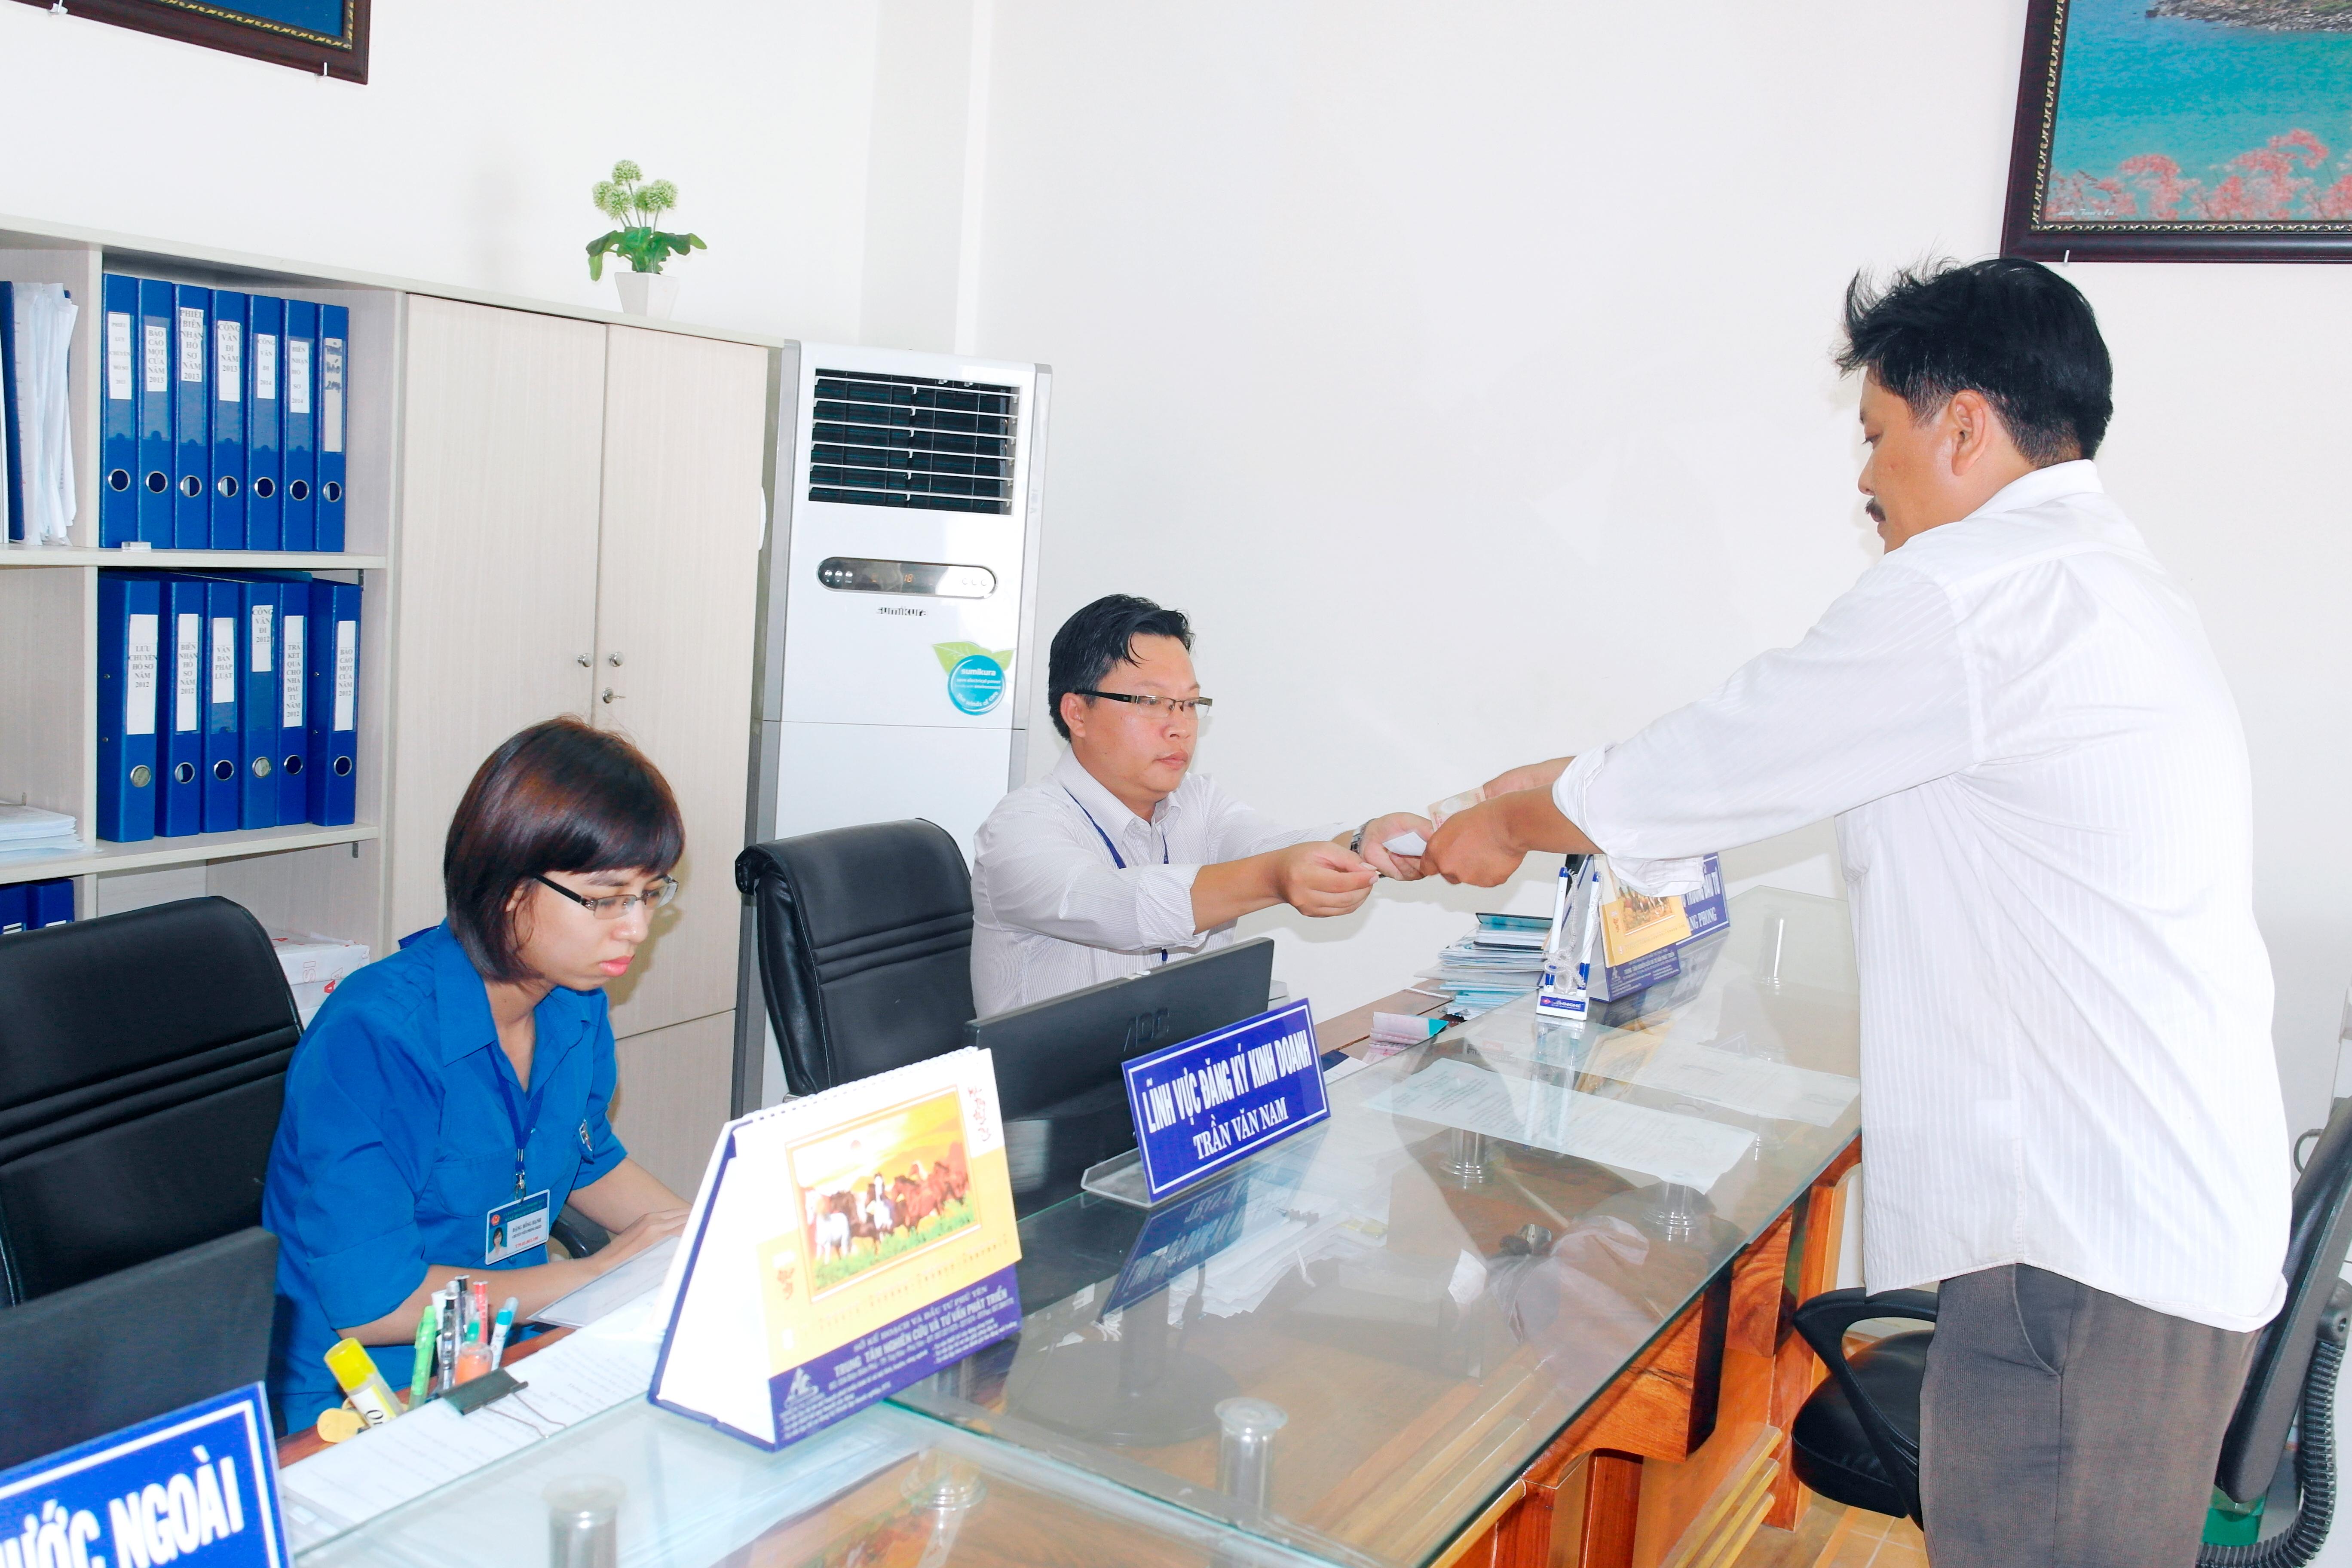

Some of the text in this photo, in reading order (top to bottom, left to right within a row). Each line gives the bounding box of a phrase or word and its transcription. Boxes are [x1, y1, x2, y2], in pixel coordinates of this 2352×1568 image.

[180, 309, 204, 319] PHIẾU
[183, 319, 201, 328] BIÊN
[148, 328, 164, 337] BÁO
[181, 331, 203, 340] NHẬN
[148, 337, 164, 346] CÁO
[221, 333, 237, 342] VĂN
[186, 340, 198, 349] HỒ
[147, 348, 164, 356] MỘT
[148, 356, 165, 365] CỬA
[148, 366, 165, 374] NĂM
[183, 361, 201, 370] NĂM
[876, 606, 928, 617] sumikura
[961, 668, 996, 676] sumikura
[1697, 907, 1718, 927] PHONG
[1142, 1029, 1312, 1133] LĨNH VỰC ĐĂNG KÝ KINH DOANH
[1193, 1097, 1289, 1160] TRẦN VĂN NAM
[833, 1285, 1008, 1378] TRUNG TÂM NGHIÊN CỨU VÀ TƯ VẤN PHÁT TRIỂN
[109, 1445, 244, 1568] NGOÀI
